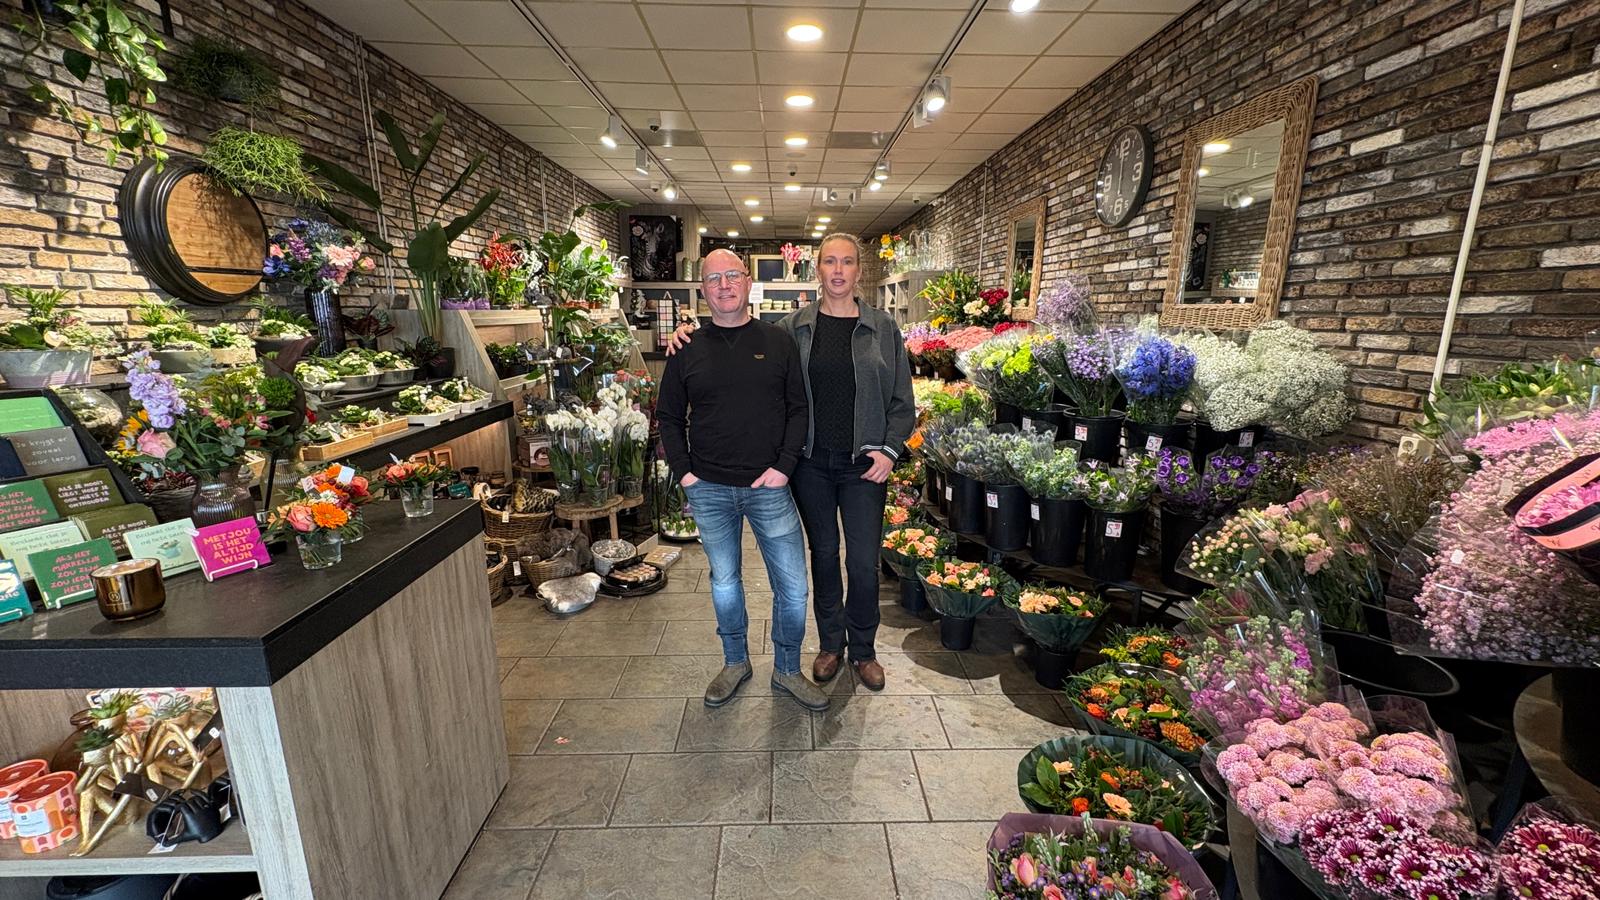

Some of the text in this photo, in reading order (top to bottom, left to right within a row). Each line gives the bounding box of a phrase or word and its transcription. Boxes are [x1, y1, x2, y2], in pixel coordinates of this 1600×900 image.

[1132, 162, 1142, 182] 3
[1103, 174, 1112, 193] 9
[1114, 197, 1123, 216] 6
[203, 527, 251, 545] MET JOU
[212, 536, 248, 551] IS HET
[56, 550, 91, 563] ALS HET
[213, 542, 254, 559] ALTIJD
[221, 550, 252, 565] WIJN
[58, 570, 76, 578] ZOU
[51, 579, 70, 588] ZOU
[63, 585, 81, 594] HET
